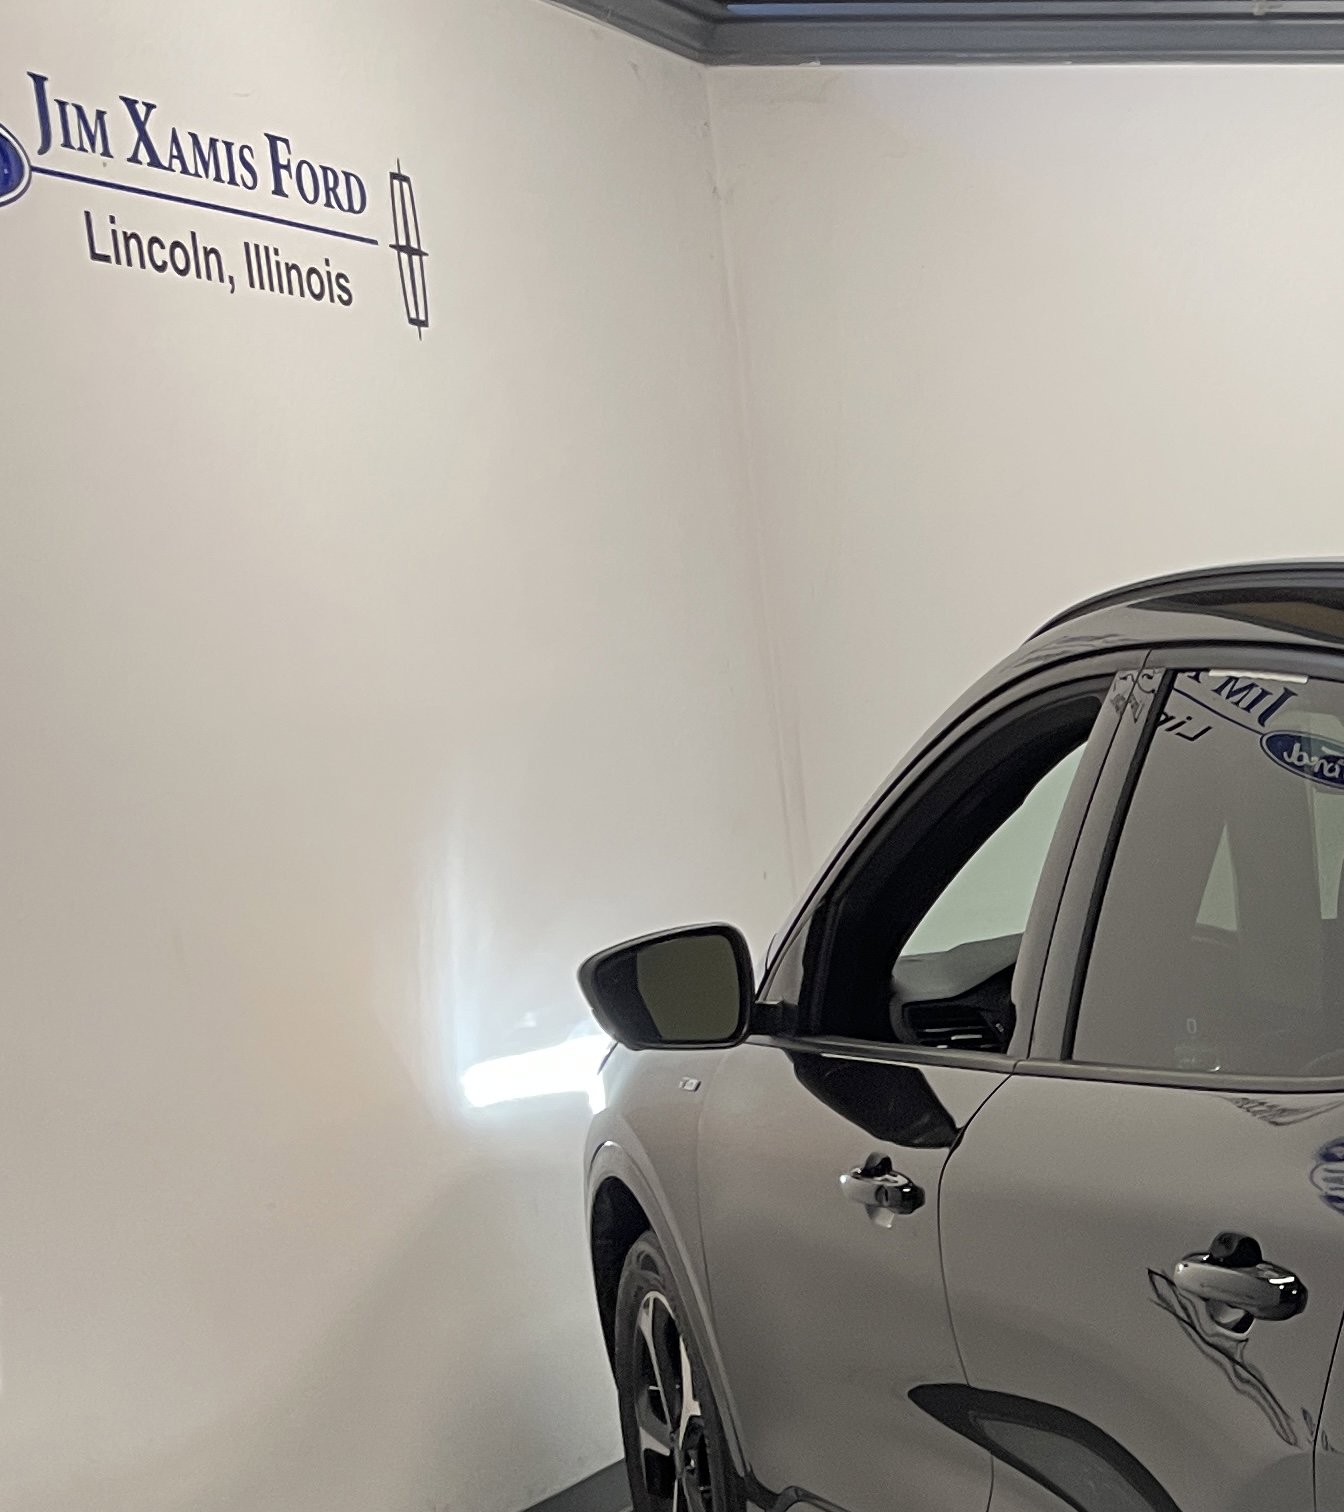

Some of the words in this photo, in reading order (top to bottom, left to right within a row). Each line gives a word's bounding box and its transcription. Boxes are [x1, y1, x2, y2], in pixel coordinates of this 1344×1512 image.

[27, 71, 114, 158] JIM
[119, 95, 259, 190] XAMIS
[264, 132, 367, 214] FORD
[84, 210, 236, 294] Lincoln,
[243, 240, 353, 307] Illinois
